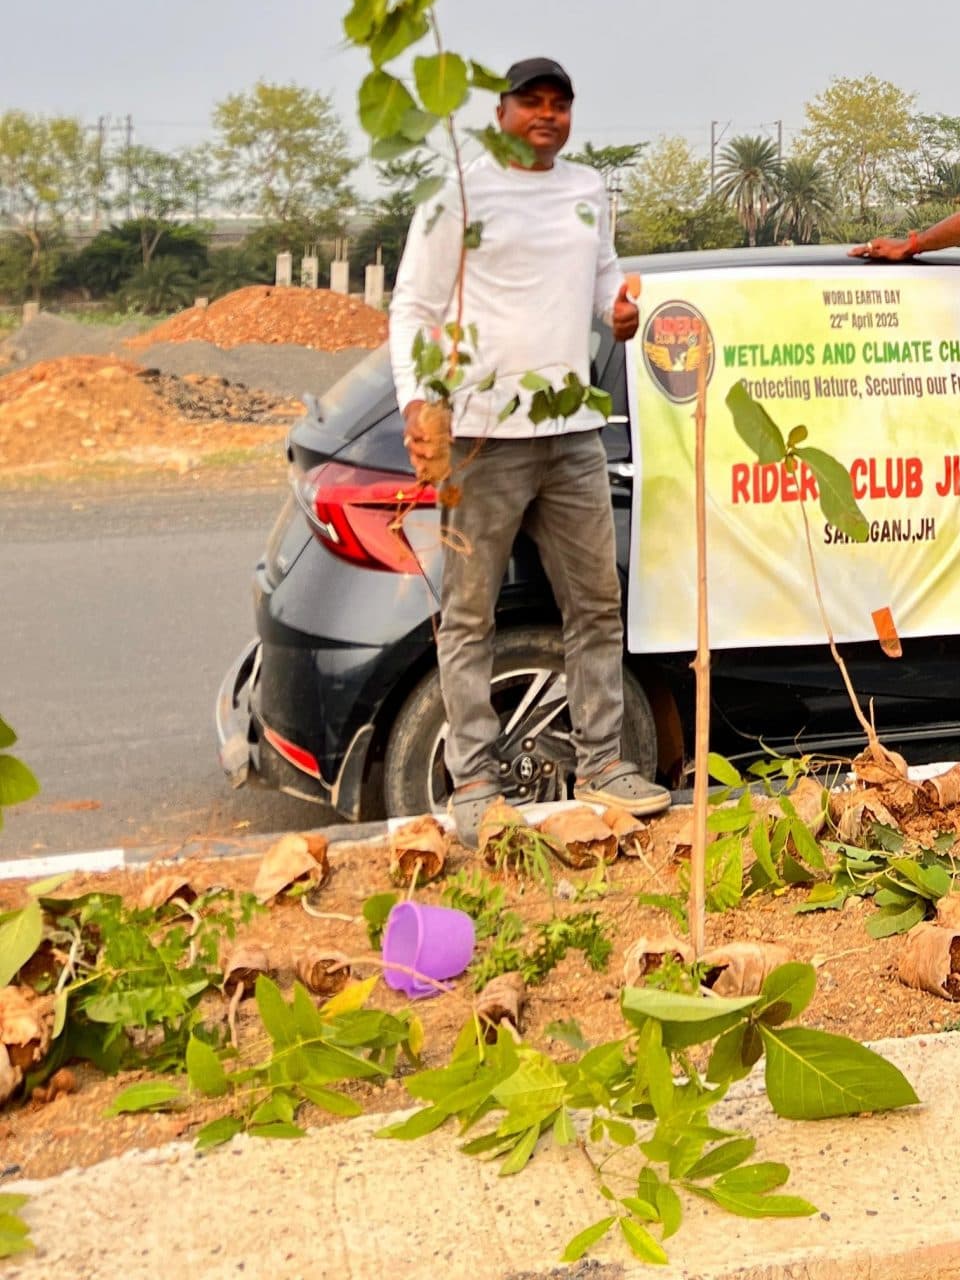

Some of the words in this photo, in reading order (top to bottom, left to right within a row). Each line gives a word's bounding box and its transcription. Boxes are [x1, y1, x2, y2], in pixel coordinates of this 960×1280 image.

[823, 290, 853, 305] WORLD
[856, 290, 882, 305] EARTH
[885, 289, 901, 304] DAY
[830, 312, 848, 329] 22nd
[852, 312, 873, 331] April
[876, 312, 899, 328] 2025
[723, 342, 816, 368] WETLANDS
[822, 342, 856, 365] AND
[862, 341, 932, 363] CLIMATE
[815, 376, 863, 399] Nature,
[865, 373, 924, 397] Securing
[927, 376, 947, 394] our
[732, 458, 819, 504] RIDER
[850, 457, 924, 500] CLUB
[823, 518, 936, 544] SAGANJ,JH
